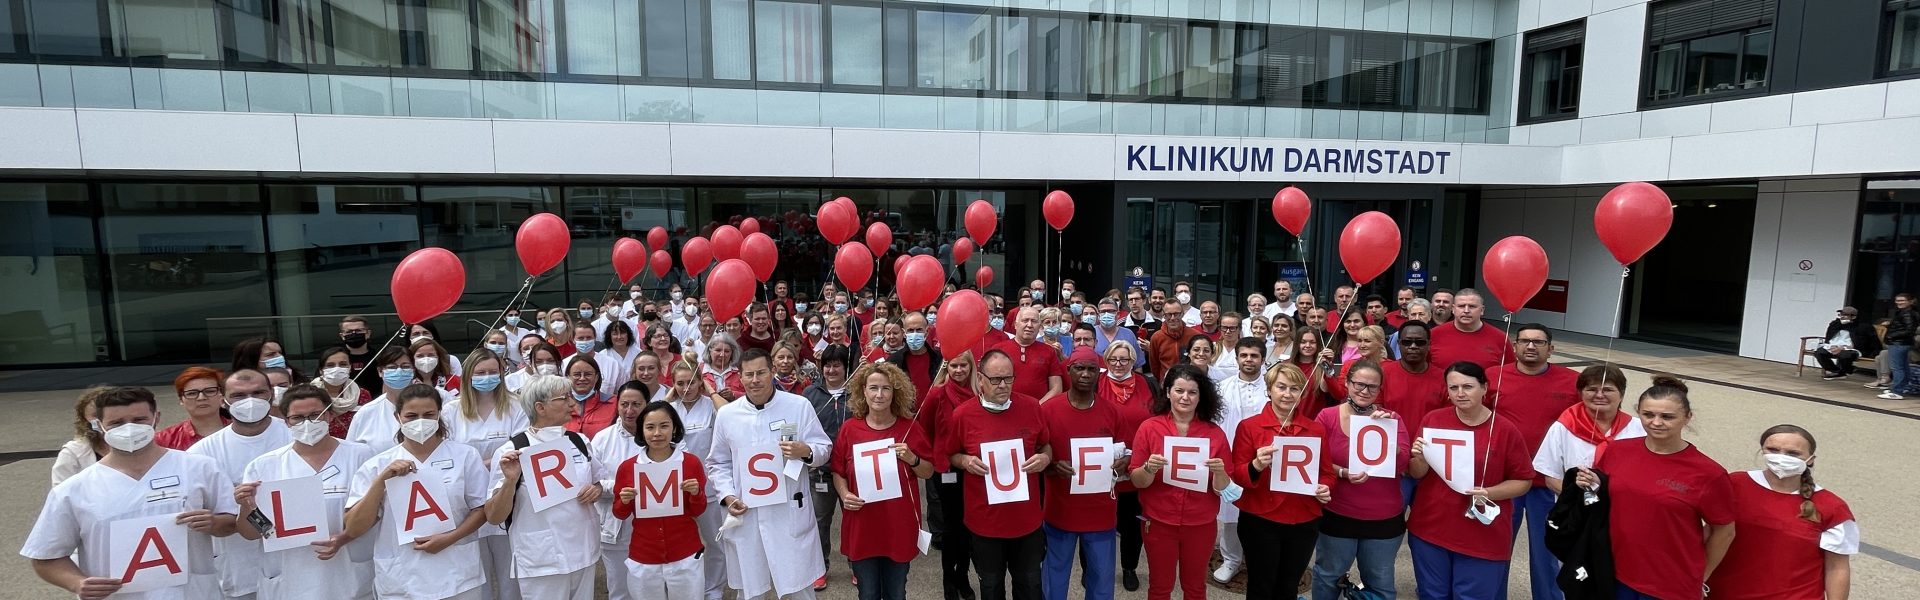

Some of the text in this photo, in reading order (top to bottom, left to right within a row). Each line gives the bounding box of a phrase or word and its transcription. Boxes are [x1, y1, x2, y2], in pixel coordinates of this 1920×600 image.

[1127, 145, 1451, 175] KLINIKUM DARMSTADT
[1079, 446, 1104, 485] F
[1170, 445, 1200, 484] E
[1280, 445, 1313, 485] R
[1357, 424, 1388, 466] O
[1432, 438, 1466, 481] T
[531, 449, 572, 497] R
[639, 469, 680, 510] M
[747, 453, 779, 497] S
[862, 448, 889, 490] T
[988, 448, 1020, 492] U
[272, 490, 316, 538] L
[406, 480, 448, 531] A
[123, 527, 181, 583] A
